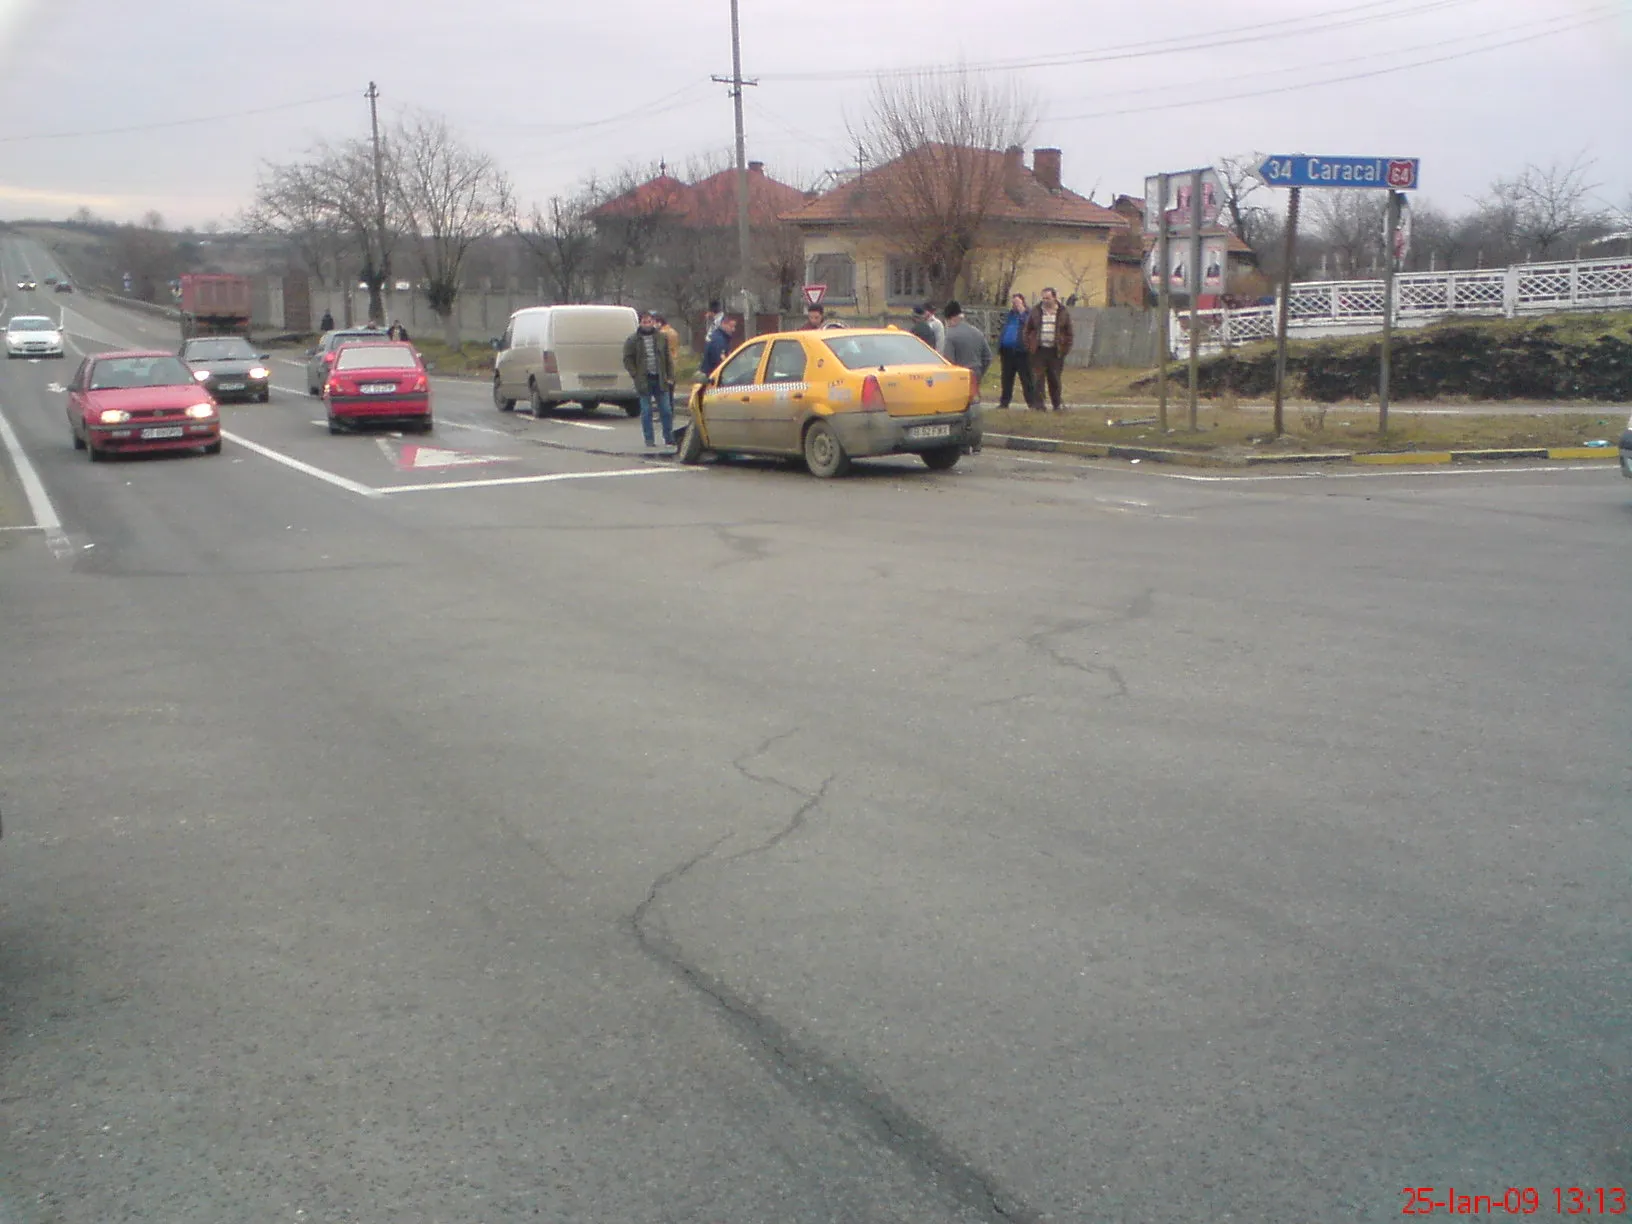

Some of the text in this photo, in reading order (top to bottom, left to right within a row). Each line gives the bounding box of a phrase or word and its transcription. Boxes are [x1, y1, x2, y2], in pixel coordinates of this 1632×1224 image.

[1268, 158, 1382, 181] 34 Caracal
[1391, 167, 1409, 184] 64
